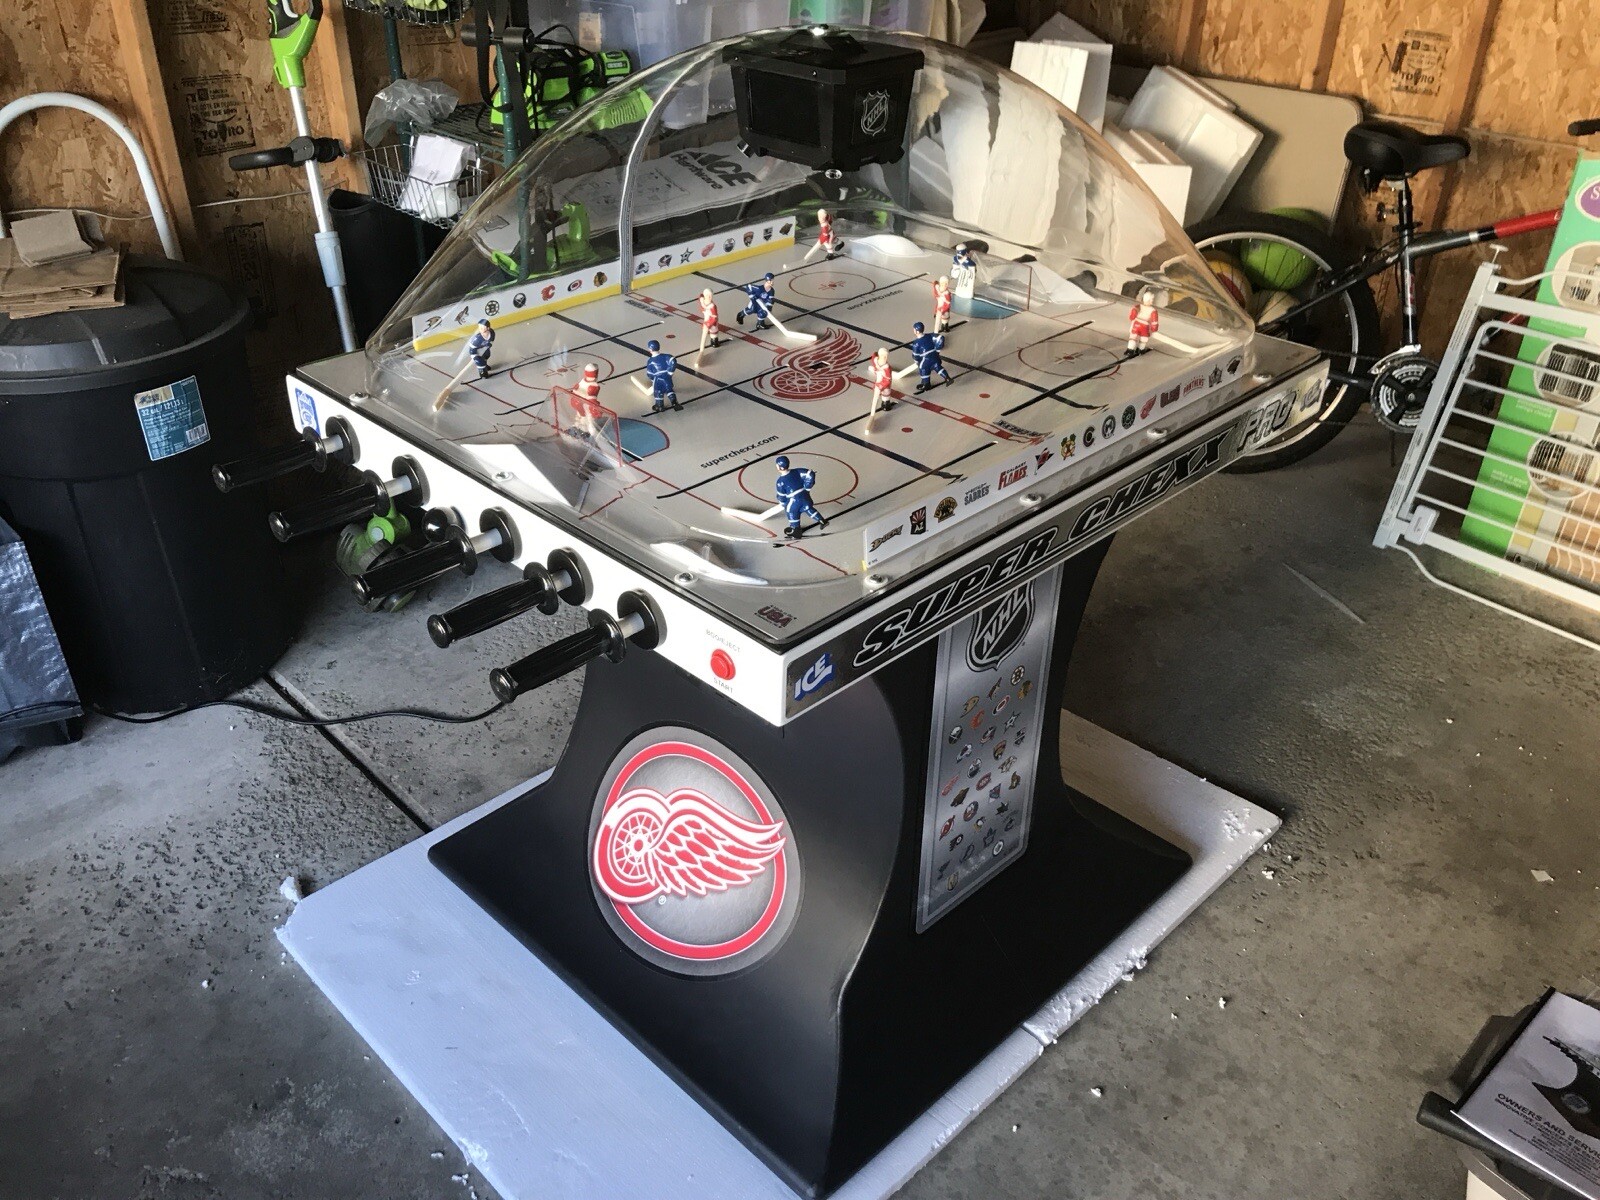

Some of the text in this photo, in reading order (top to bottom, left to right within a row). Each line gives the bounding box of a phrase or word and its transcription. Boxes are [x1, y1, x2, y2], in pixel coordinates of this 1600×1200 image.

[669, 153, 723, 190] Hardware
[686, 151, 762, 187] ACE
[700, 435, 780, 469] superchexx.com
[964, 485, 990, 506] SABRES
[997, 465, 1028, 491] FLAMES
[852, 389, 1298, 669] SUPER CHEXX PRO
[982, 587, 1025, 655] NHL
[713, 677, 734, 694] START
[794, 651, 835, 701] ICE
[1497, 1092, 1543, 1122] OWNERS
[1543, 1120, 1566, 1136] AND
